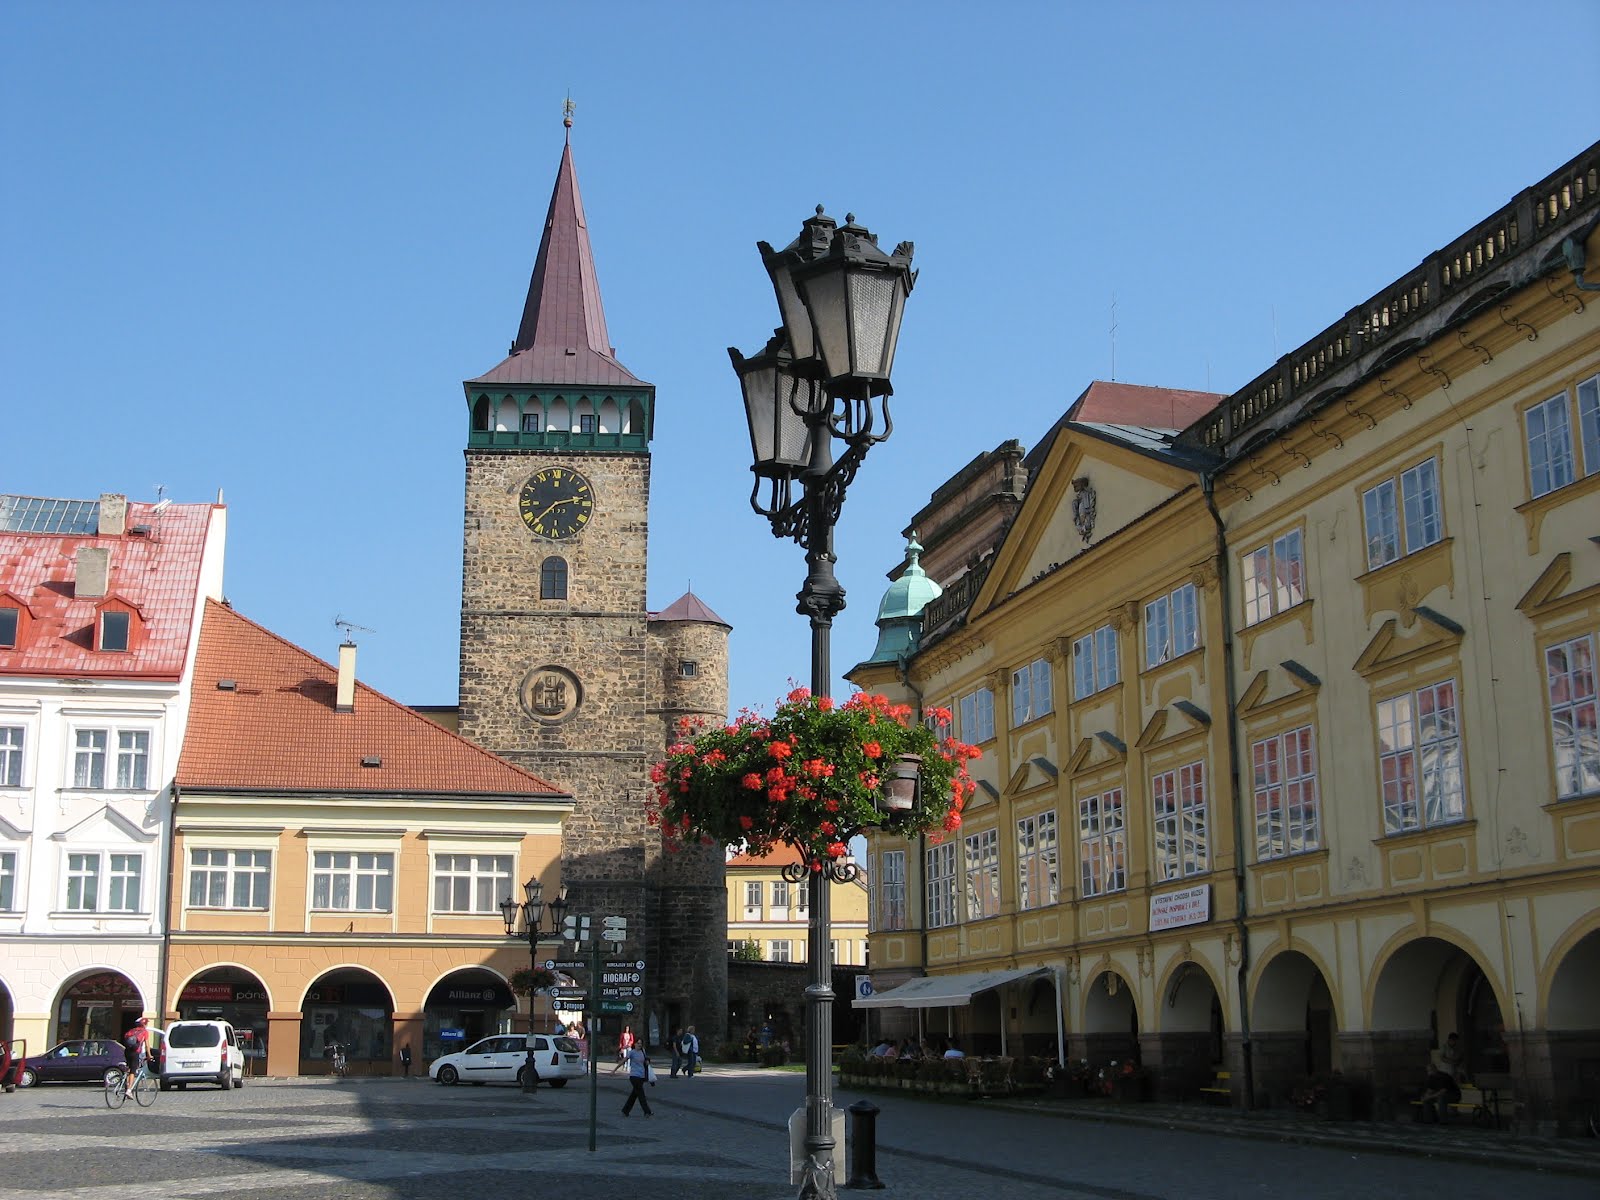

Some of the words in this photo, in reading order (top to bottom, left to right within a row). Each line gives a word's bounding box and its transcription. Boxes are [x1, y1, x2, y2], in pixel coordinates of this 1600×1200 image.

[603, 973, 632, 983] BIOGRAF
[449, 990, 481, 999] Allianz
[603, 987, 618, 995] ZÁMEK
